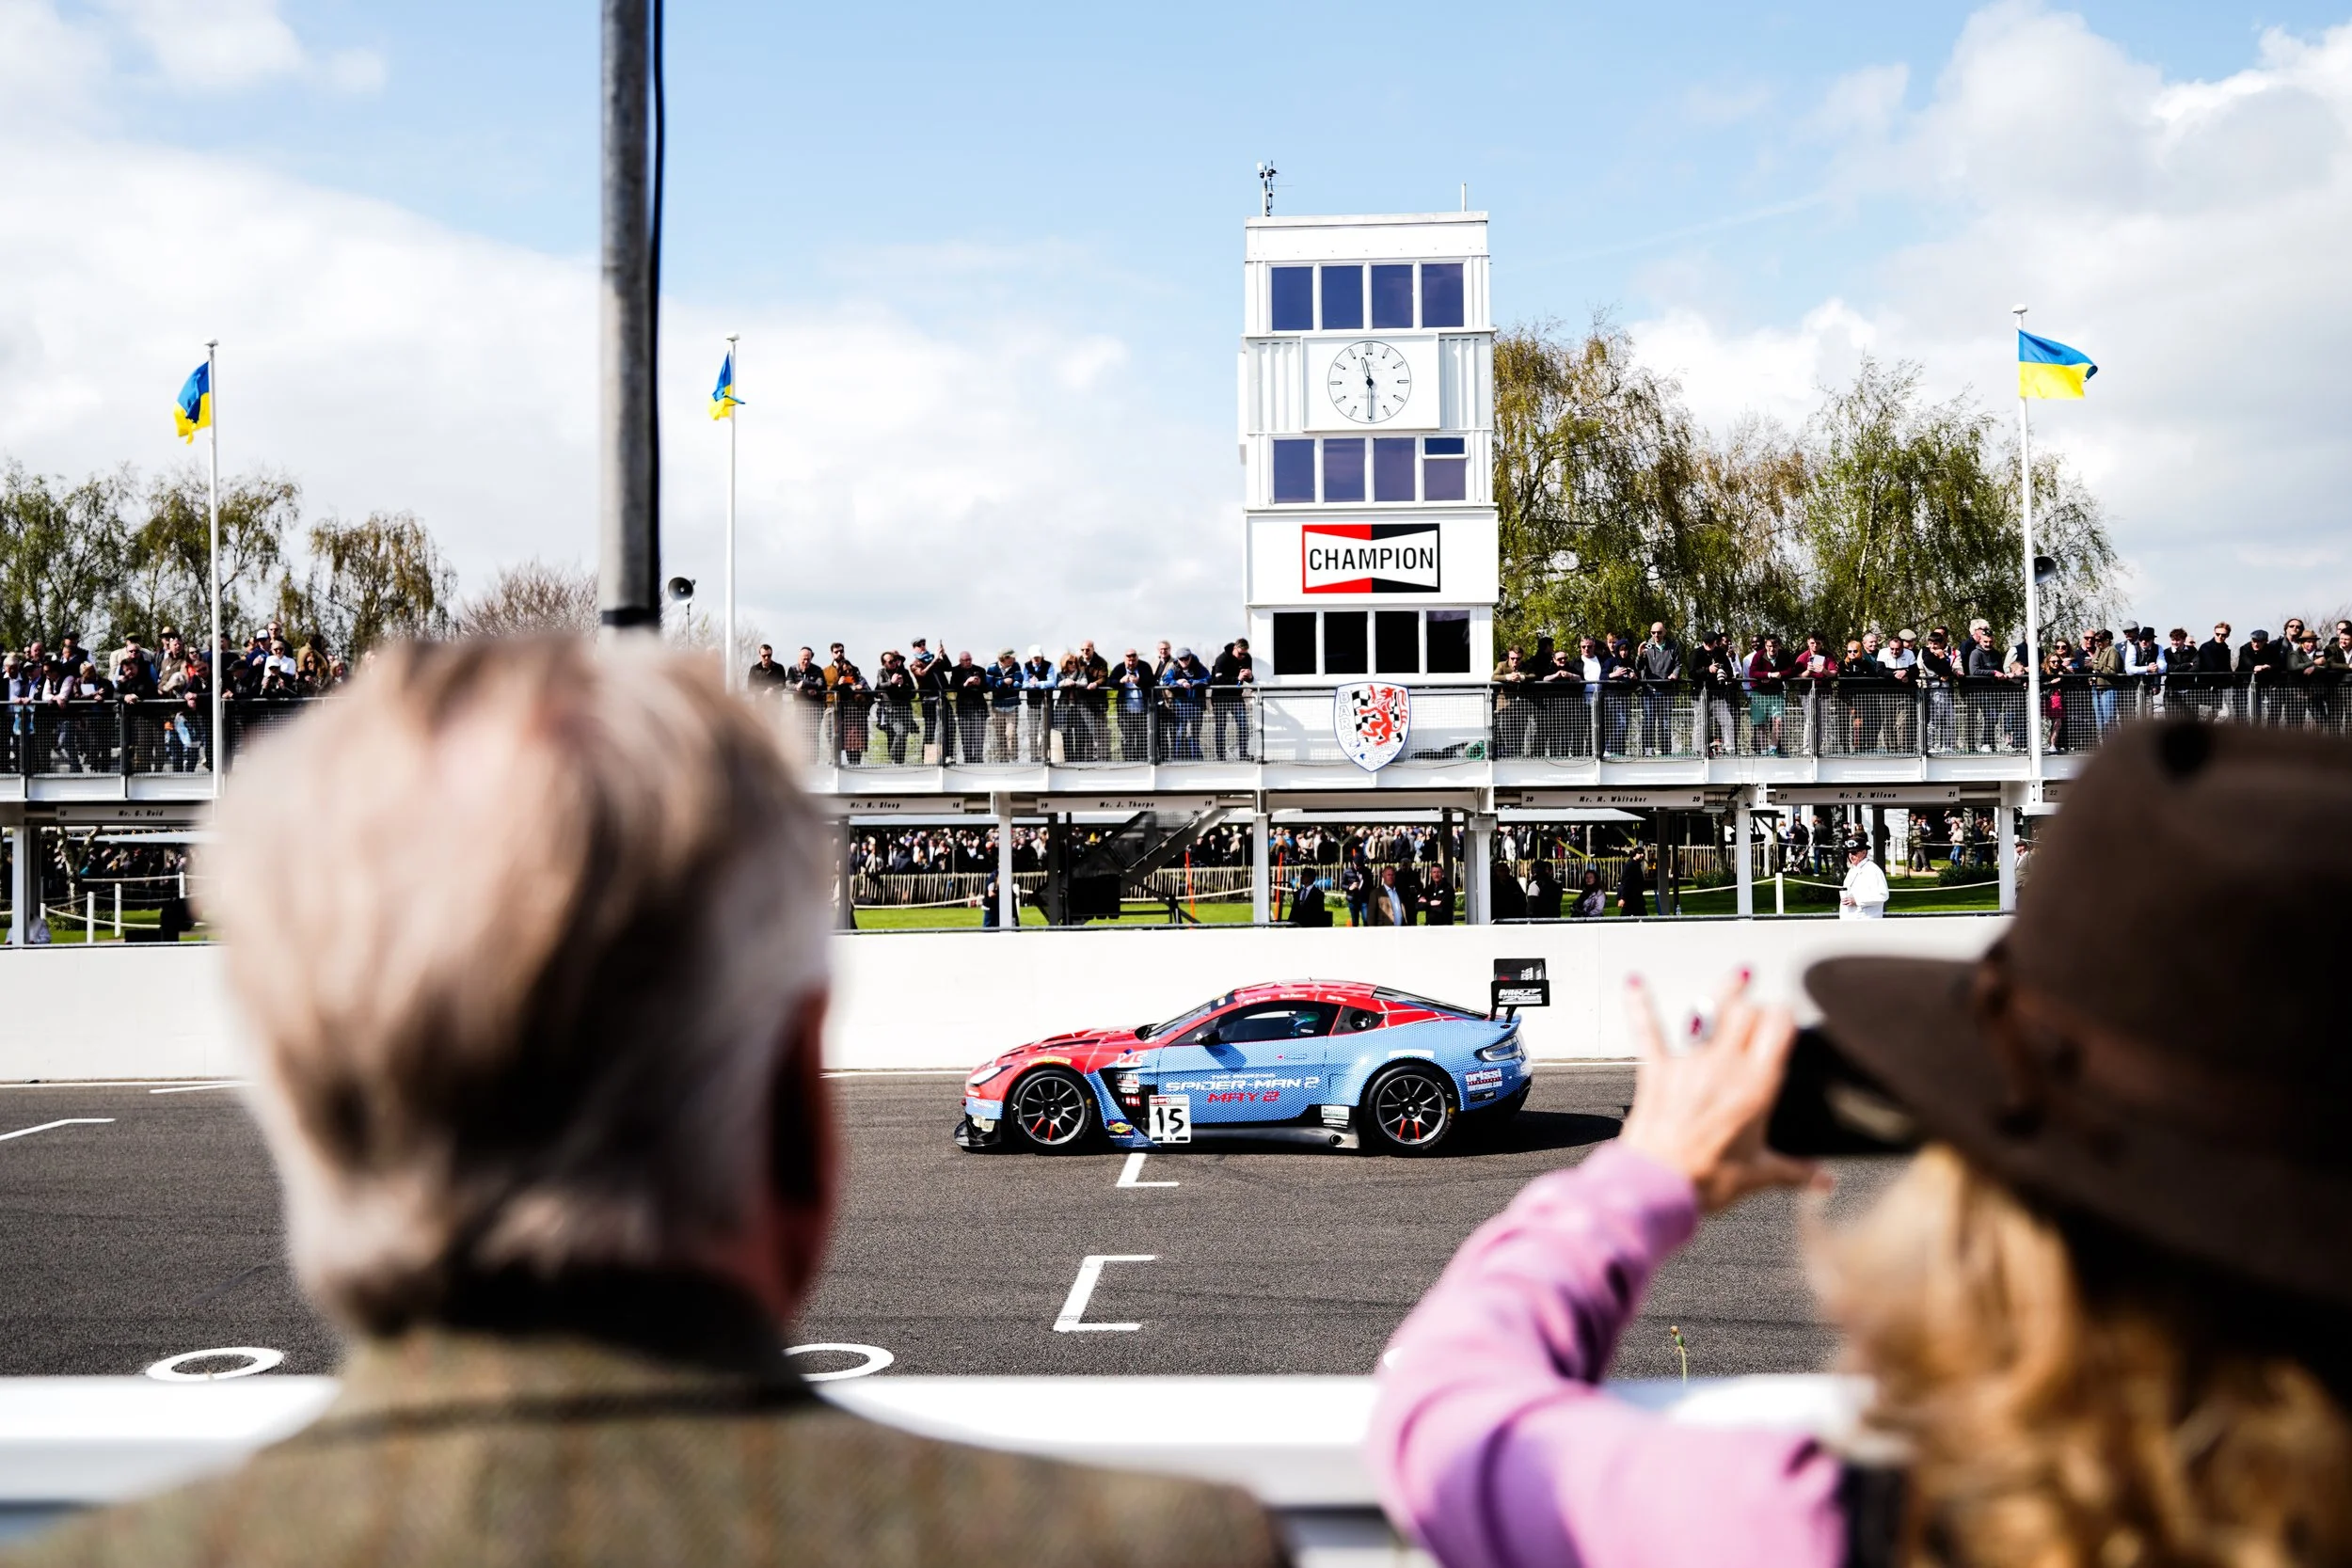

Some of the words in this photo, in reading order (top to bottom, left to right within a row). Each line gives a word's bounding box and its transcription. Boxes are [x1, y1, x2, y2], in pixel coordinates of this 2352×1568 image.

[1309, 547, 1434, 570] CHAMPION
[1339, 691, 1353, 744] BARC
[880, 801, 900, 810] Sleep
[1129, 800, 1155, 809] Thorpe
[1166, 1079, 1301, 1092] SPIDER-MAN
[1303, 1077, 1320, 1089] 2
[1207, 1091, 1258, 1103] MAY
[1263, 1090, 1279, 1102] 2
[1155, 1106, 1184, 1135] 15
